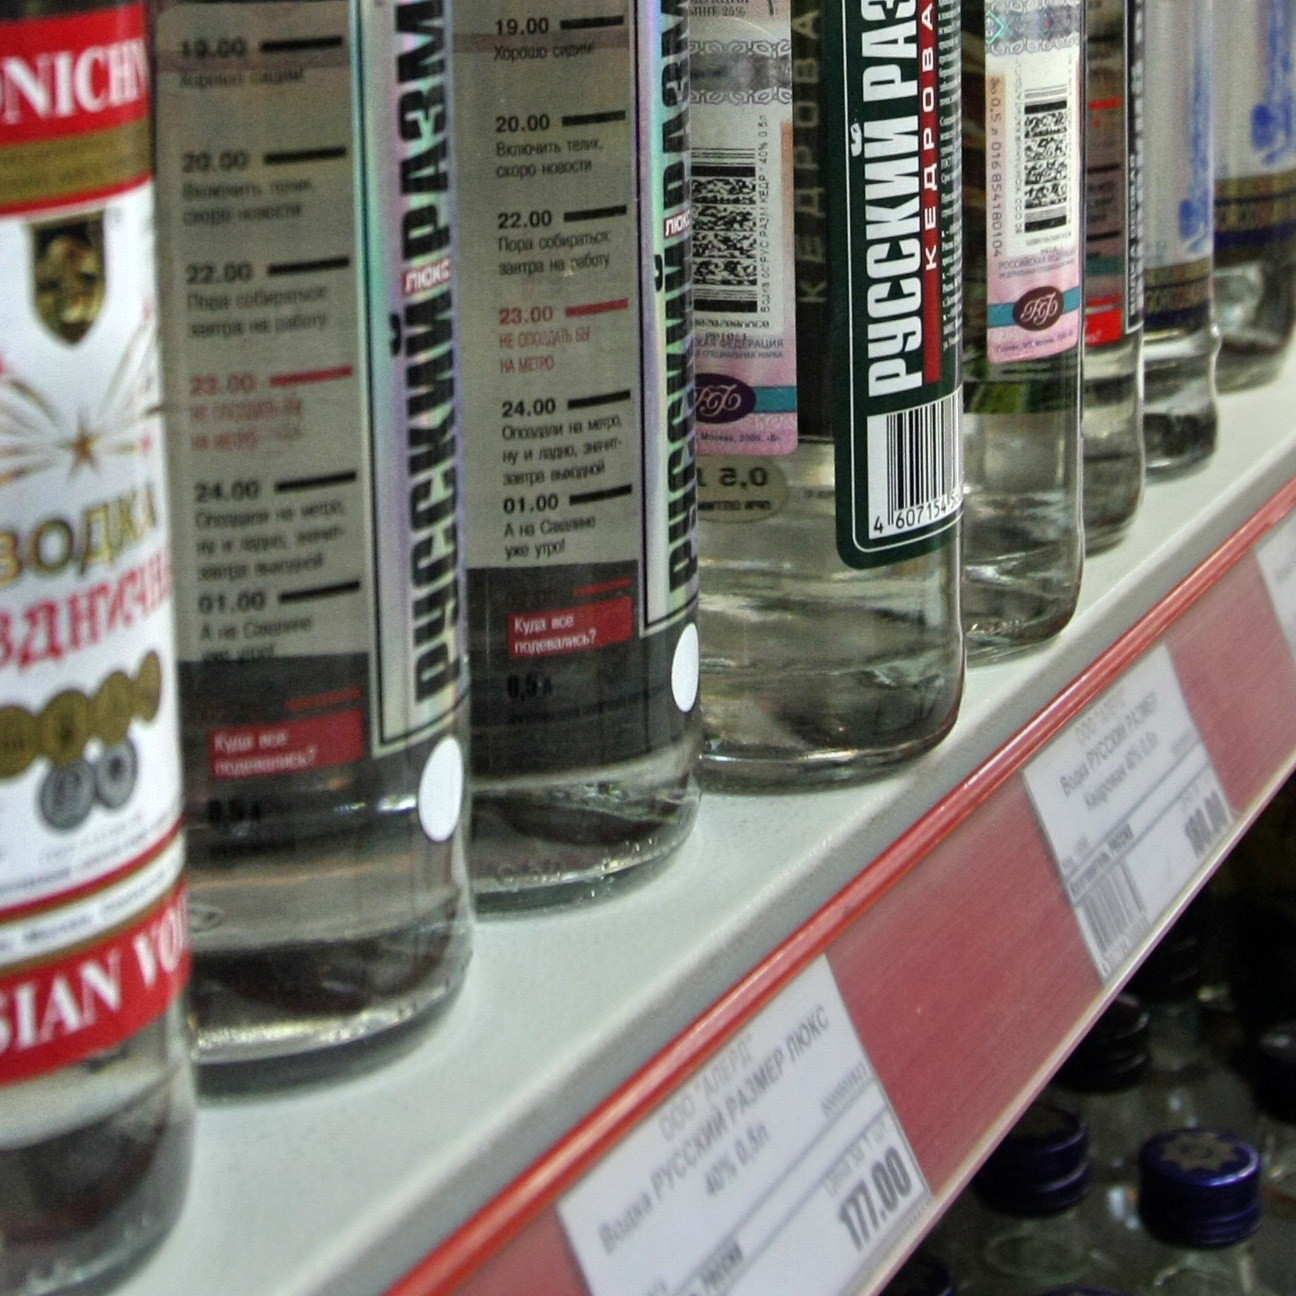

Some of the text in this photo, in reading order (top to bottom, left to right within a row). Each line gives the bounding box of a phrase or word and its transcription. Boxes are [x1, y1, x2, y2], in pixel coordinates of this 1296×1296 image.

[495, 17, 550, 36] 19.00
[495, 114, 551, 134] 20.00
[496, 140, 562, 157] Включить
[991, 141, 1002, 169] 016
[496, 159, 592, 180] скоро новости
[497, 210, 552, 230] 22.00
[991, 173, 1003, 258] 854180104
[497, 236, 533, 254] Пора
[849, 114, 924, 398] РУССКИЙ
[186, 261, 252, 284] 22.00
[498, 260, 544, 277] завтра
[549, 258, 565, 272] на
[498, 306, 554, 326] 23.00
[500, 355, 555, 374] НА МЕТРО
[501, 397, 556, 418] 24.00
[502, 448, 520, 465] ну
[523, 447, 534, 460] и
[502, 468, 546, 488] завтра
[195, 480, 261, 503] 24.00
[503, 494, 560, 516] 01.00
[504, 520, 515, 537] А
[518, 522, 536, 537] на
[503, 544, 530, 564] уже
[198, 591, 267, 615] 01.00
[513, 614, 575, 635] Куда все
[513, 628, 597, 656] подевались?
[650, 1108, 728, 1202] РУССКИЙ
[724, 1046, 787, 1128] РАЗМЕР
[784, 1003, 832, 1062] ЛЮКС
[837, 1145, 914, 1255] 177.00
